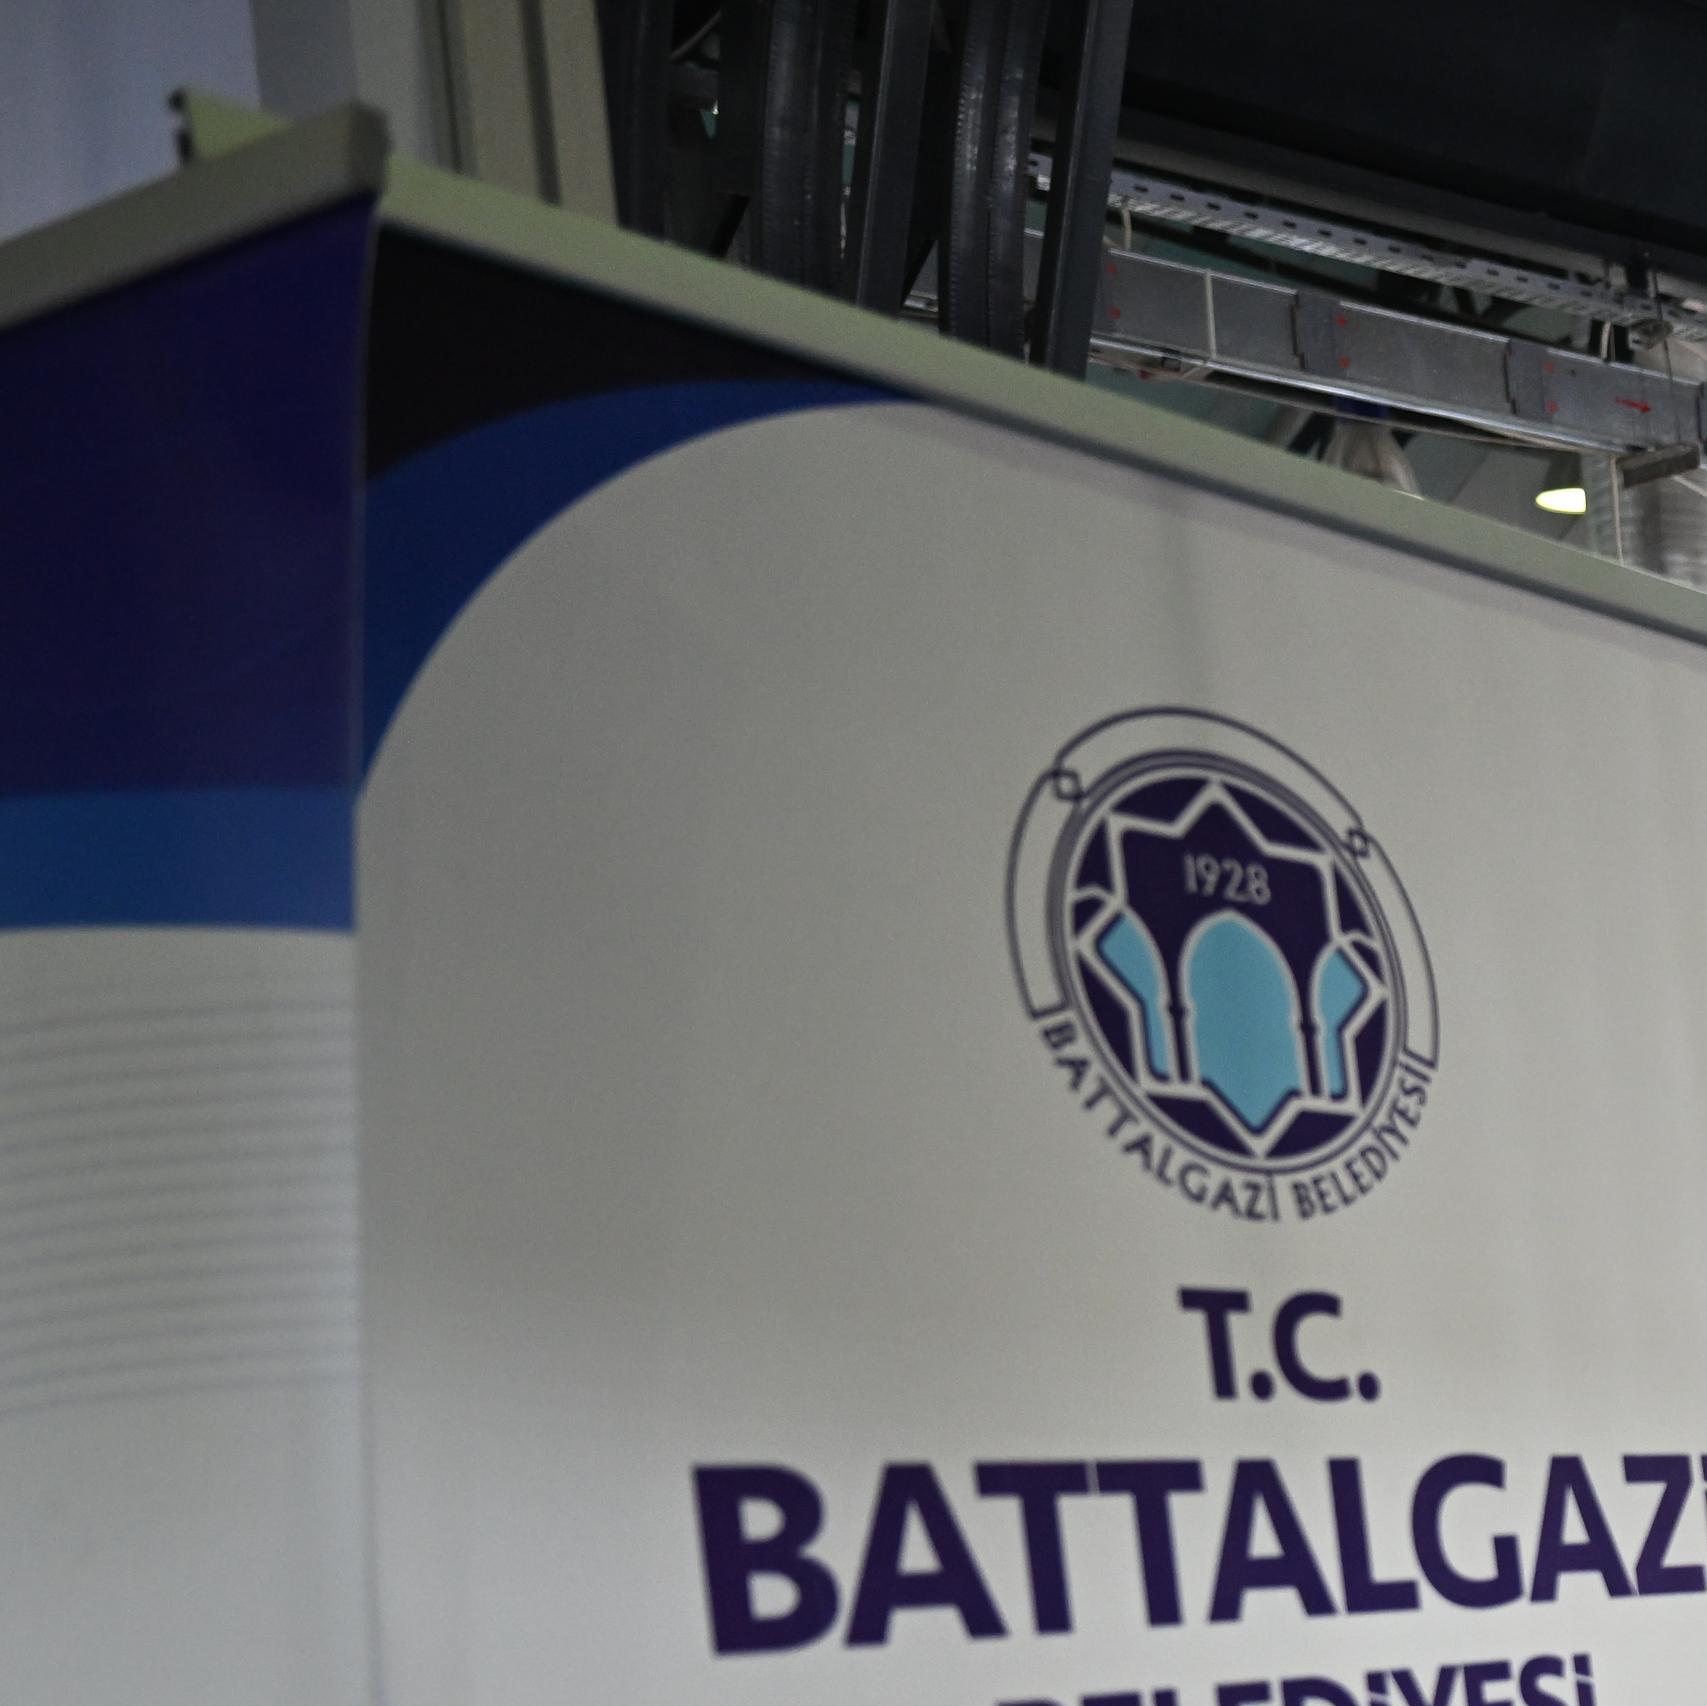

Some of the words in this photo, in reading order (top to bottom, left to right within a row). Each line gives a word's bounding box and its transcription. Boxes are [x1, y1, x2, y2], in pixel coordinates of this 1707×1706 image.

[1182, 852, 1272, 905] 1928
[1042, 1017, 1281, 1223] BATTALGAZİ
[1178, 1287, 1381, 1402] T.C.
